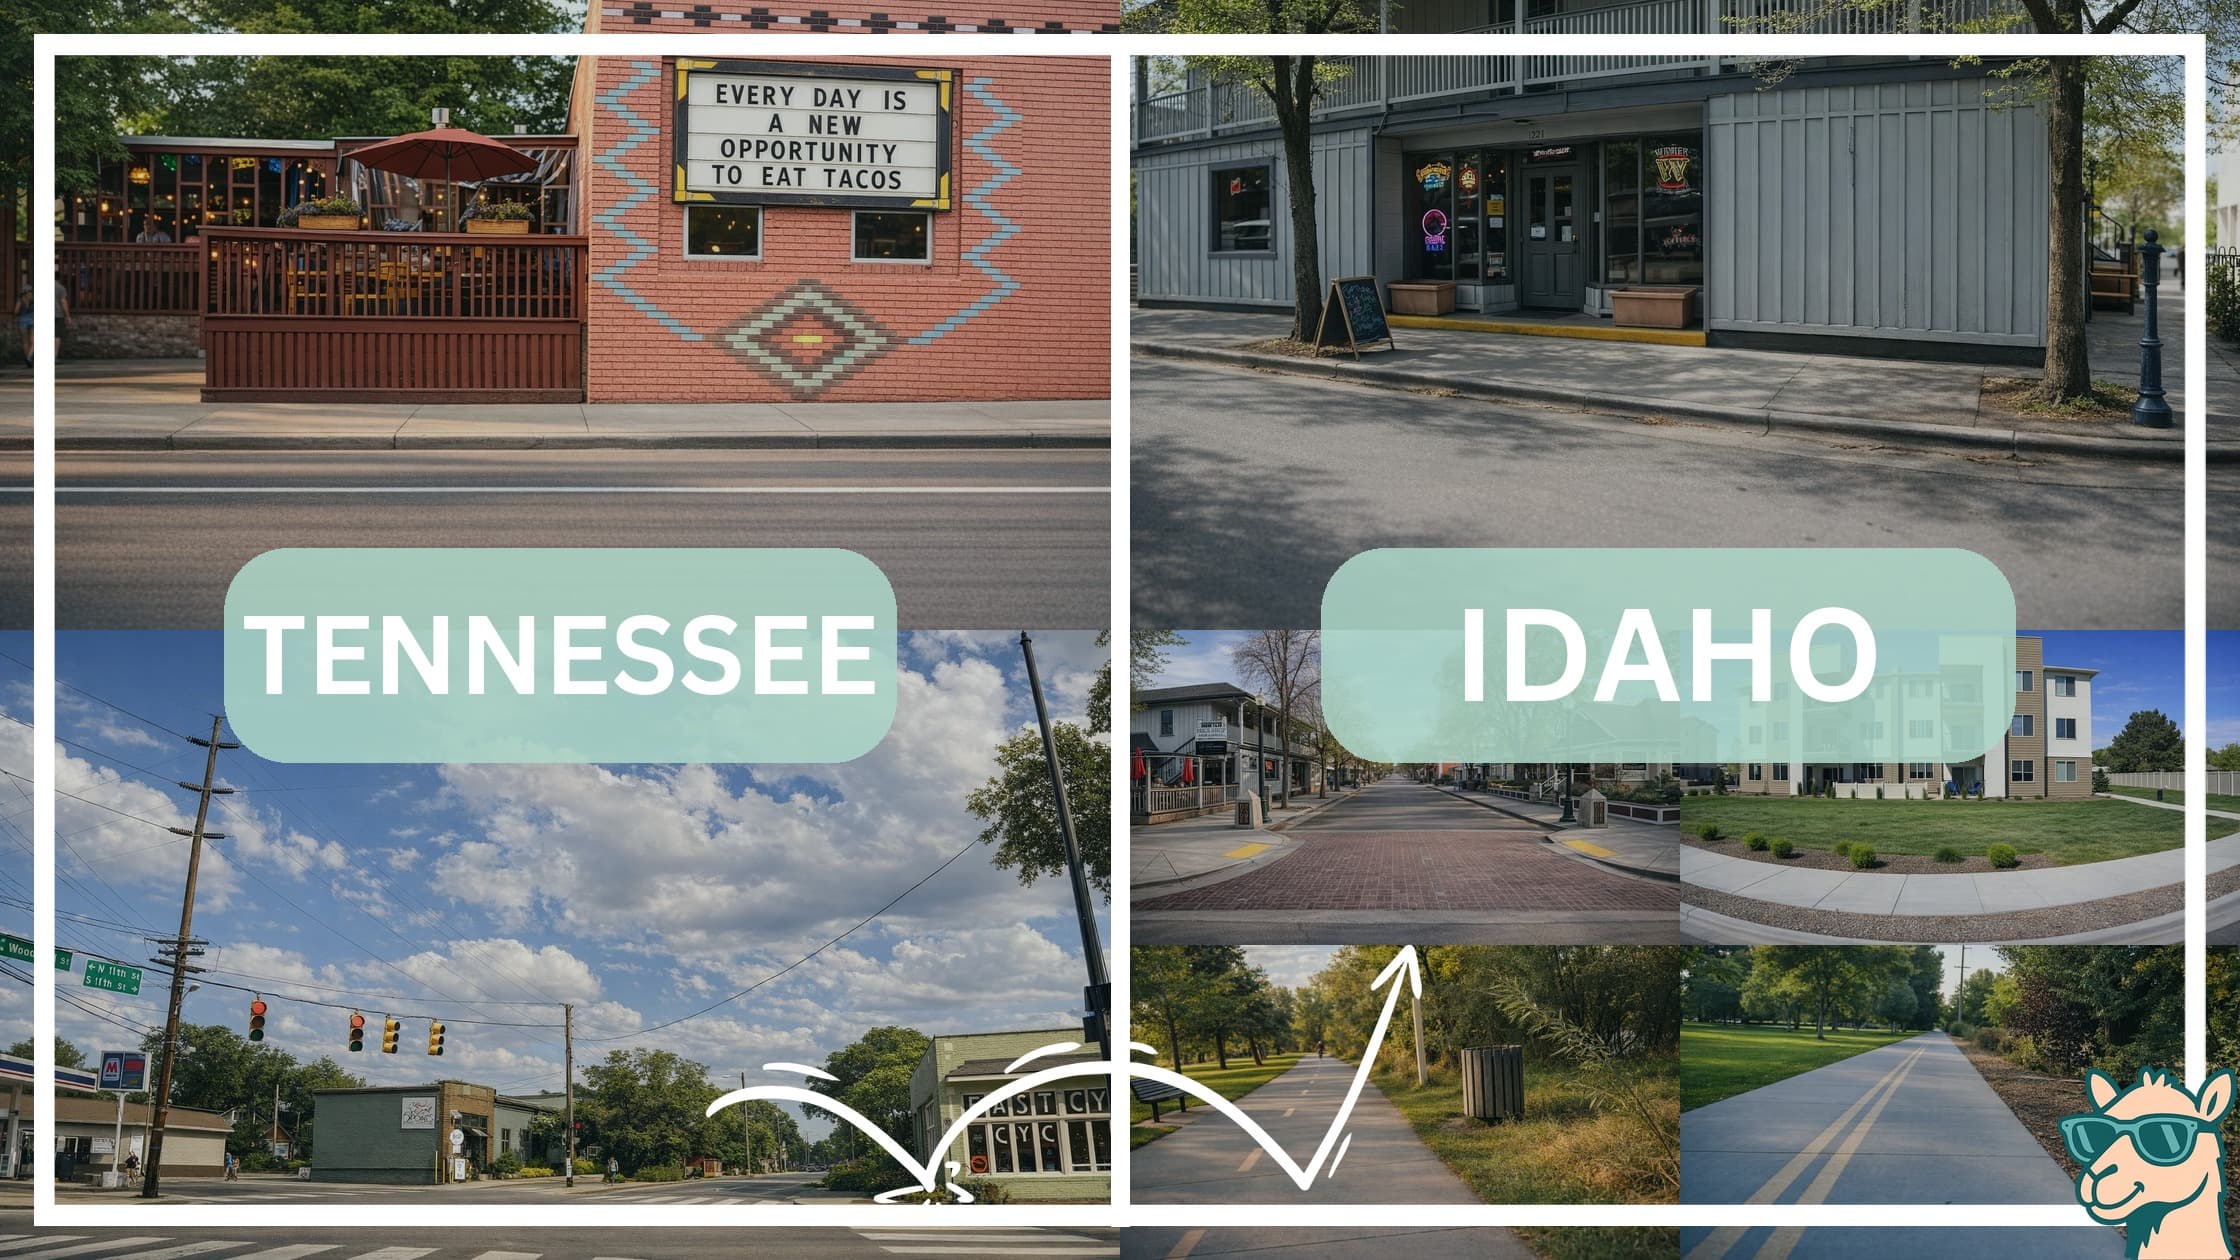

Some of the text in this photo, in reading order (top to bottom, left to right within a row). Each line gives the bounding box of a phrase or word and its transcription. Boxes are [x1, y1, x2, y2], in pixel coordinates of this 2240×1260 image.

[716, 84, 906, 111] EVERY DAY IS
[768, 113, 862, 135] A NEW
[721, 138, 897, 164] OPPORTUNITY
[712, 164, 901, 190] TO EAT TACOS
[86, 975, 91, 984] S
[95, 977, 112, 989] 11th
[98, 964, 105, 973] N
[109, 965, 126, 978] 11th
